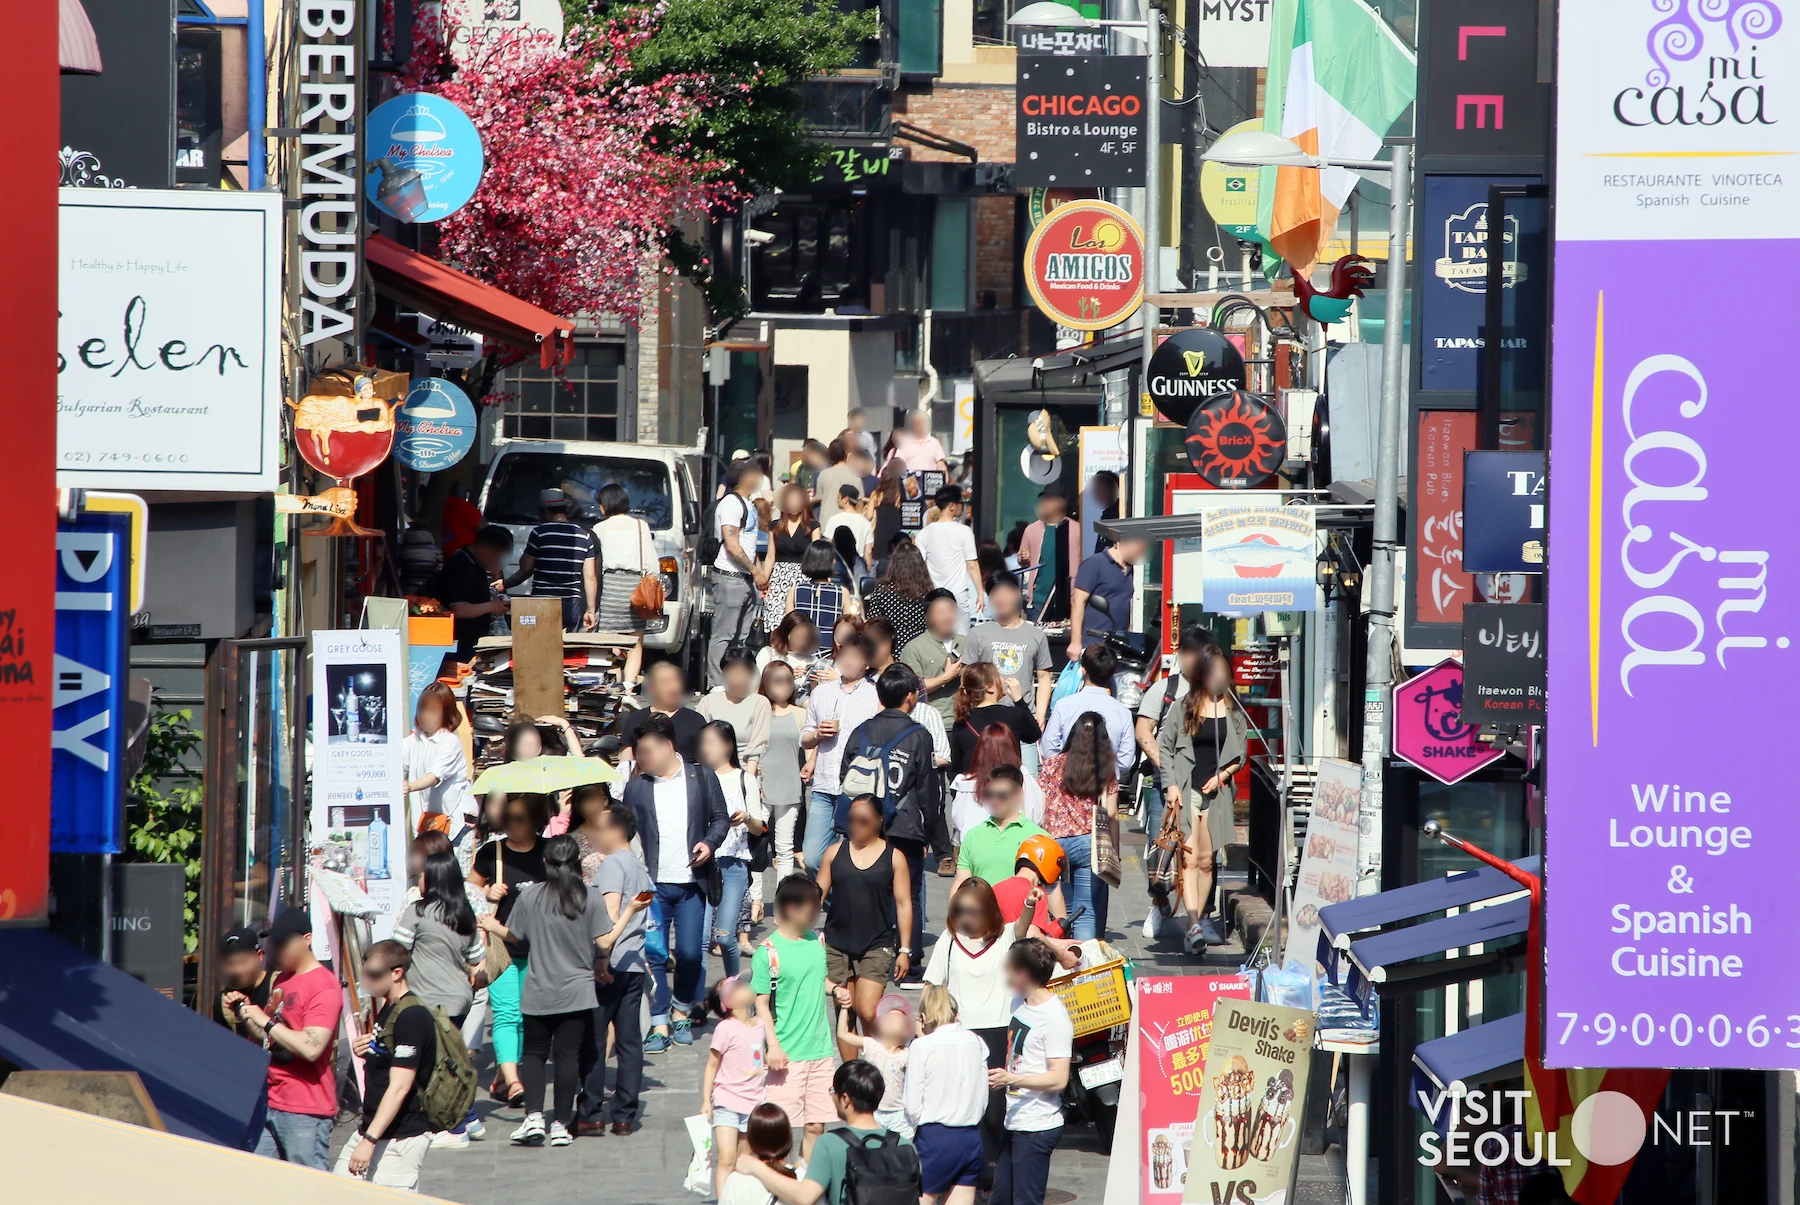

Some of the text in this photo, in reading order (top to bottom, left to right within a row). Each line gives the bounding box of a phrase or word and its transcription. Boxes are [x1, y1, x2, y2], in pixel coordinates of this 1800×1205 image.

[1709, 45, 1767, 79] mi
[1022, 94, 1140, 116] CHICAGO
[1613, 80, 1780, 127] casa
[1027, 122, 1137, 139] Bistro & Lounge
[386, 143, 454, 160] My Chelsea
[889, 148, 903, 159] 2F
[1100, 142, 1137, 156] 4F, 5F
[300, 0, 357, 348] BERMUDA
[811, 148, 889, 182] 갈비
[1604, 173, 1783, 187] RESTAURANTE VINOTECA
[1636, 193, 1751, 209] Spanish Cuisine
[1070, 226, 1107, 249] Los
[1452, 231, 1513, 244] TAPS
[71, 258, 113, 272] Healthy
[126, 259, 164, 274] Happy
[166, 260, 187, 272] Life
[1046, 254, 1132, 282] AMIGOS
[1452, 267, 1484, 275] TAPAS
[1050, 282, 1076, 290] Mexican
[1435, 338, 1485, 348] TAPAS
[1151, 376, 1238, 397] GUINNESS
[126, 396, 209, 419] Restaurant
[417, 421, 462, 437] Chelsea
[1219, 435, 1252, 446] BricX
[1442, 419, 1452, 469] Itaewon
[99, 452, 189, 463] 749-0600
[1427, 426, 1437, 495] Korean Pub
[302, 498, 328, 511] Mona
[1620, 353, 1717, 698] casa
[1716, 549, 1791, 671] mi
[154, 625, 183, 636] Restaurant
[188, 625, 199, 635] Pub
[1478, 618, 1542, 659] 이태
[327, 644, 383, 654] GREY GOOSE
[1478, 685, 1523, 695] Itaewon
[1484, 700, 1523, 709] Korean
[1423, 746, 1476, 758] SHAKE
[327, 791, 390, 800] BOMBAY SAPPHIRE
[1631, 784, 1732, 813] Wine
[1609, 818, 1752, 856] Lounge
[1667, 864, 1694, 894] &
[1611, 903, 1752, 940] Spanish
[1611, 946, 1743, 977] Cuisine
[1176, 1009, 1210, 1028] 立即使用
[1228, 1009, 1280, 1041] Devil's
[1255, 1039, 1296, 1064] Shake
[1210, 1179, 1257, 1205] VS
